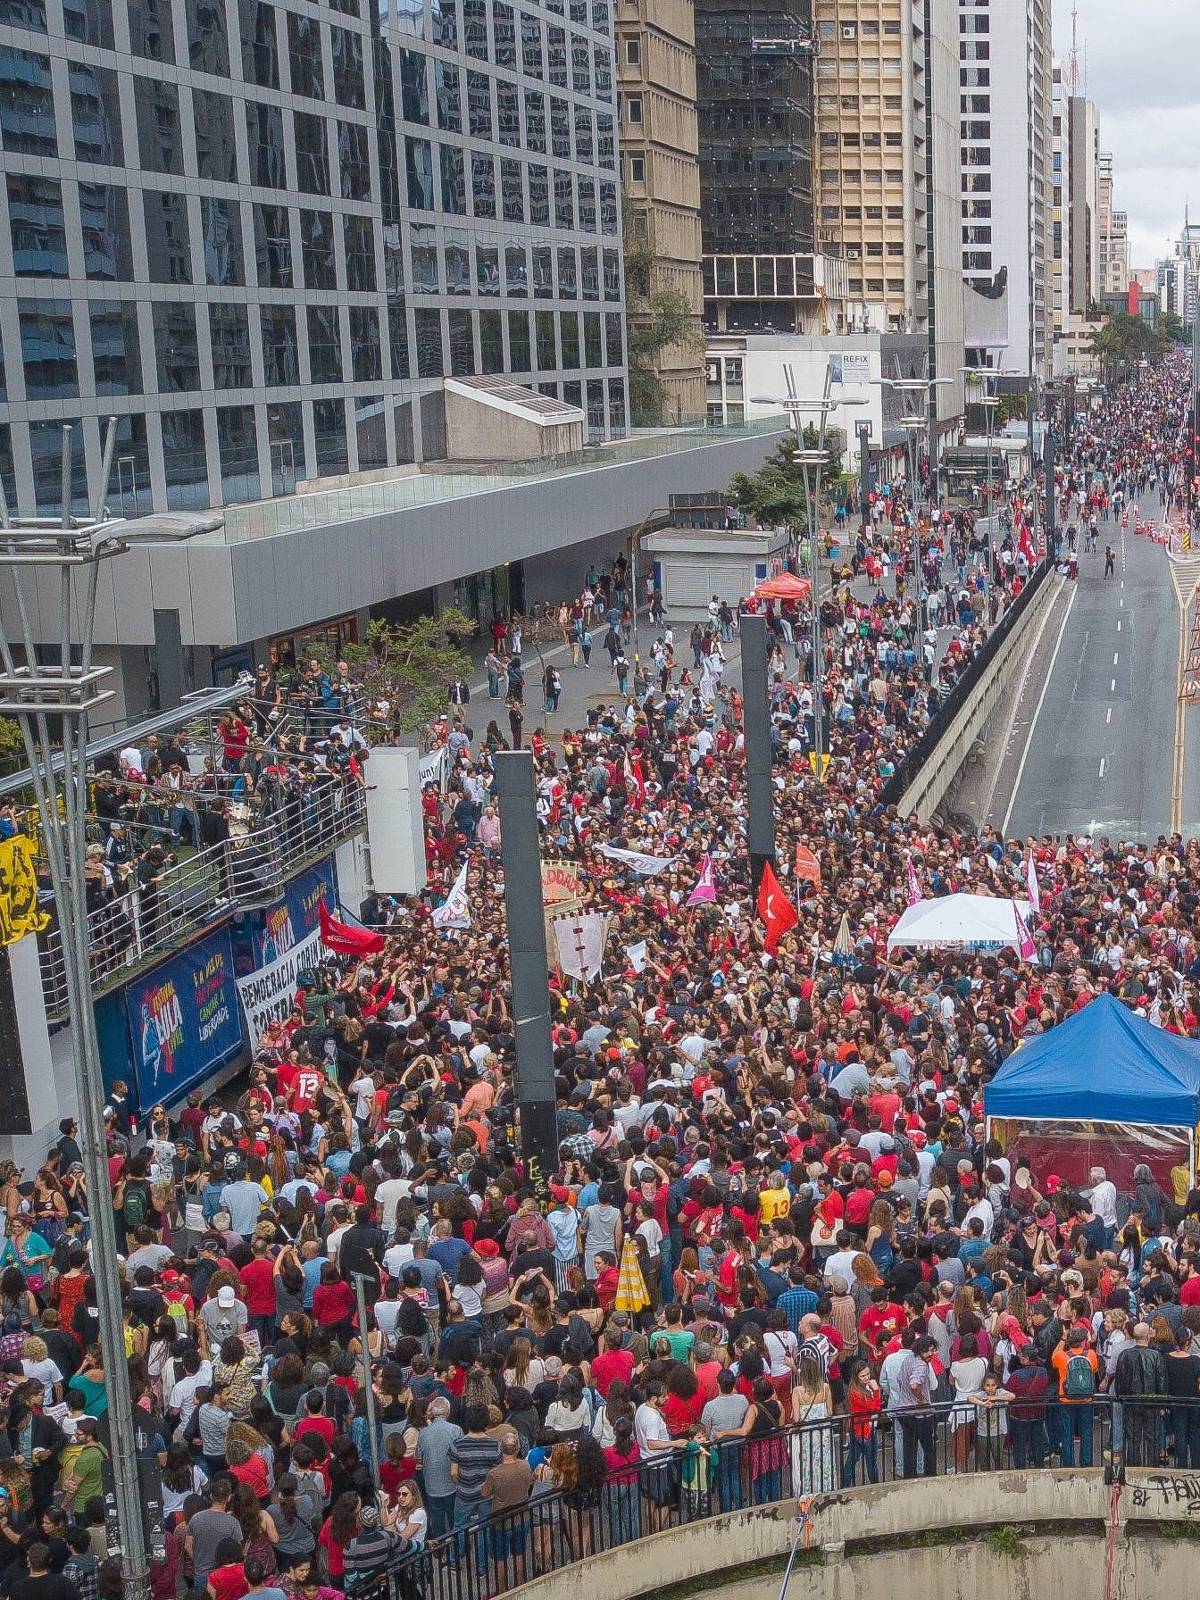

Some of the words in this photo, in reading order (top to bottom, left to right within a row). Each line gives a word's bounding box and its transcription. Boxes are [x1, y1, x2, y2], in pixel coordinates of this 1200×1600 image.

[843, 355, 868, 363] REFIX
[241, 959, 295, 1010] DEMOCRACIA
[773, 1199, 789, 1217] 13
